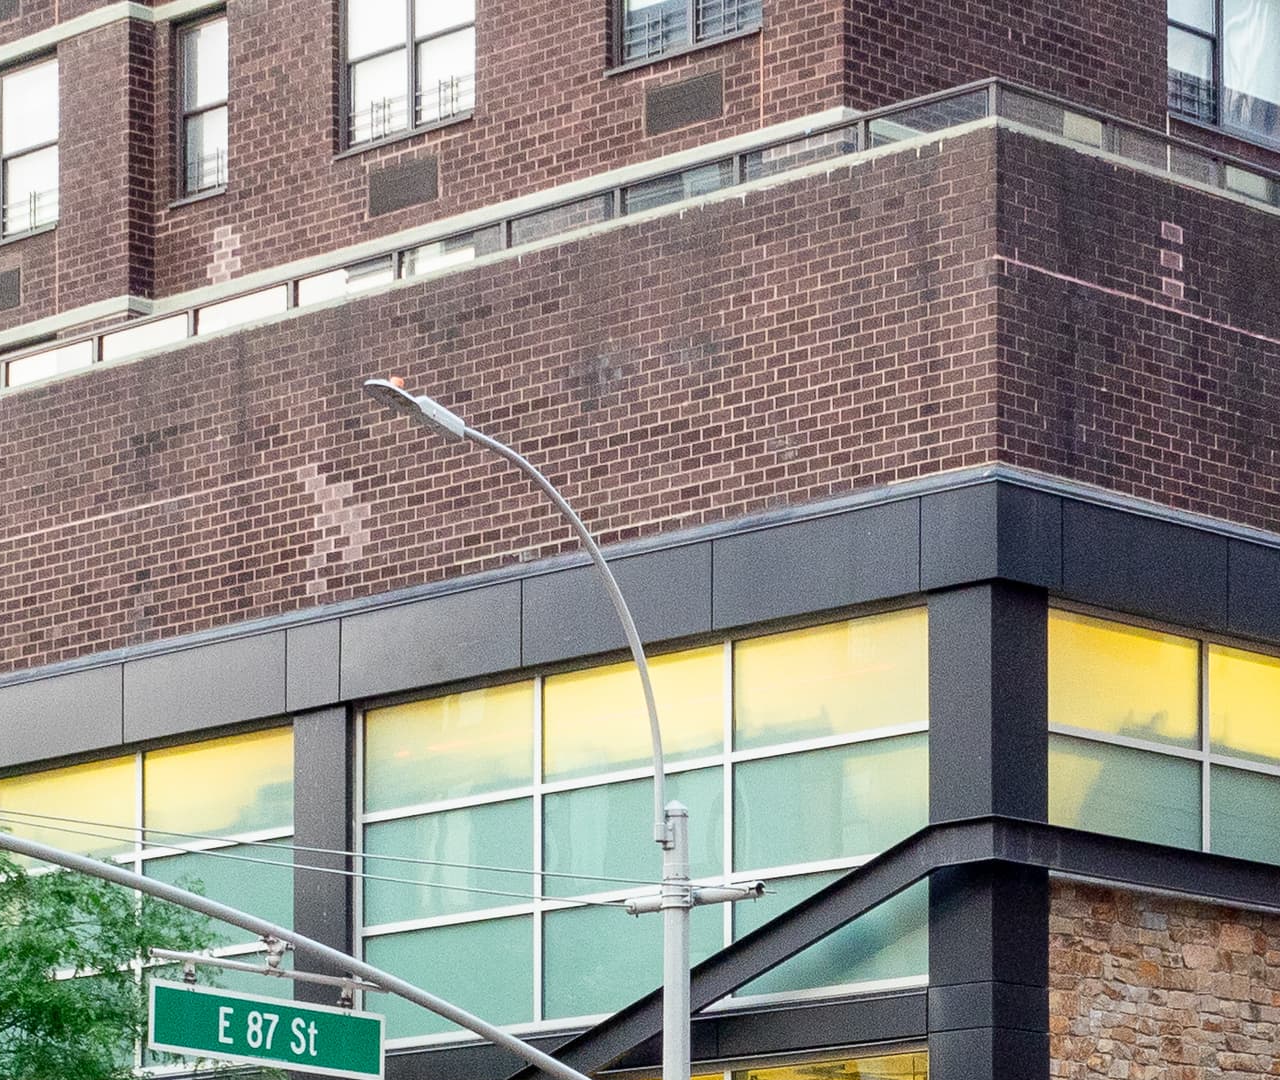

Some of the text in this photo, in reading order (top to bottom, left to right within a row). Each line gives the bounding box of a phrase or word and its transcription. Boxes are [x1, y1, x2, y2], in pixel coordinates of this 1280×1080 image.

[218, 1006, 319, 1057] E 87 St
